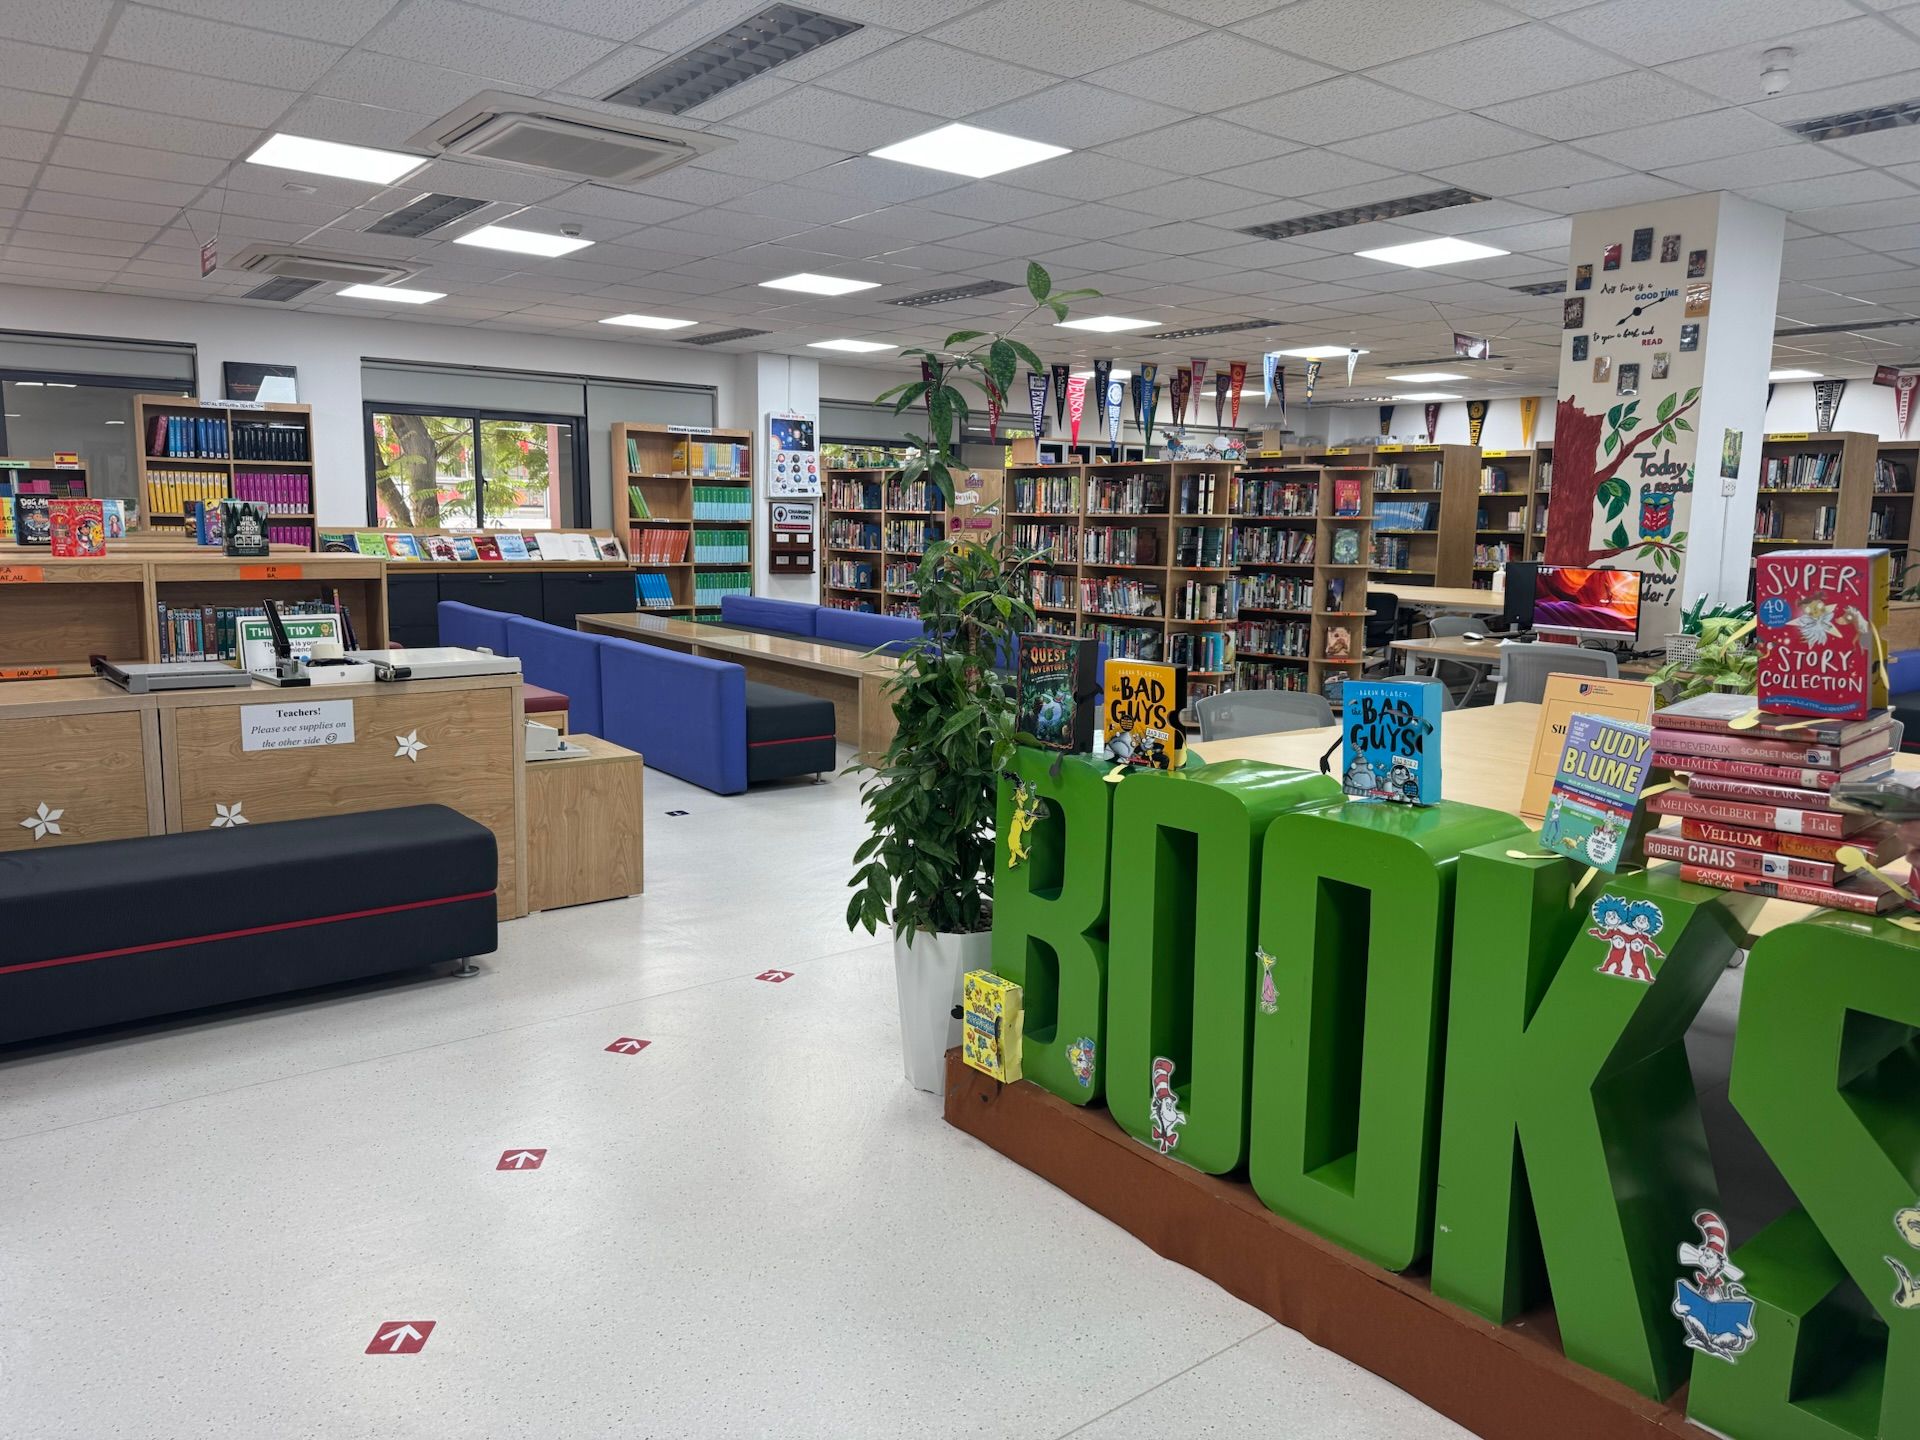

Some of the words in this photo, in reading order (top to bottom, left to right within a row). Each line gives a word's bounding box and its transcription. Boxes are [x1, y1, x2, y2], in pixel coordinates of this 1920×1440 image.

[1620, 283, 1636, 293] time
[1637, 283, 1644, 292] is
[1634, 292, 1658, 301] GOOD
[1593, 331, 1600, 342] to
[1622, 328, 1640, 338] book
[1641, 326, 1655, 336] and
[1641, 338, 1663, 346] READ
[1068, 378, 1087, 423] DENISON
[1031, 390, 1045, 437] EVANSVILLE
[1470, 419, 1482, 447] MICHIGA
[1633, 449, 1687, 481] Today
[20, 498, 37, 507] DOG
[1766, 563, 1860, 596] SUPER
[1763, 599, 1784, 614] 40
[287, 626, 315, 636] TIDY
[1030, 646, 1067, 663] QUEST
[1777, 646, 1853, 674] STORY
[1030, 664, 1069, 675] ADVENTURES
[1111, 684, 1121, 692] the
[1120, 676, 1165, 703] BAD
[1760, 670, 1863, 693] COLLECTION
[276, 707, 321, 718] Teachers!
[1110, 699, 1167, 729] GUYS
[1361, 697, 1414, 727] BAD
[251, 724, 281, 735] Please
[299, 721, 333, 733] supplies
[262, 739, 275, 748] the
[278, 737, 302, 747] other
[303, 736, 321, 745] side
[1350, 723, 1416, 757] GUYS
[1589, 727, 1651, 763] JUDY
[1656, 739, 1678, 749] JUDE
[1680, 741, 1731, 754] DEVERAUX
[1740, 747, 1779, 758] SCARLET
[1562, 746, 1643, 793] BLUME
[1660, 756, 1677, 765] NO
[1681, 759, 1719, 771] LIMITS
[1730, 765, 1775, 777] MICHAEL
[1694, 780, 1723, 790] MARY
[1723, 782, 1763, 796] HIGGINS
[1765, 789, 1802, 800] CLARK
[1660, 799, 1707, 814] MELISSA
[1709, 806, 1759, 821] GILBERT
[1808, 817, 1837, 832] Tale
[1591, 837, 1613, 849] COMPLETE
[1699, 824, 1763, 847] VELLUM
[1648, 842, 1685, 857] ROBERT
[1687, 845, 1736, 868] CRAIS
[1788, 861, 1815, 878] RULE
[1696, 870, 1722, 880] CATCH
[1725, 874, 1735, 883] AS
[1698, 878, 1714, 886] CAT
[1715, 880, 1733, 889] CAN
[1800, 889, 1817, 897] MAE
[1819, 890, 1852, 904] BROWN
